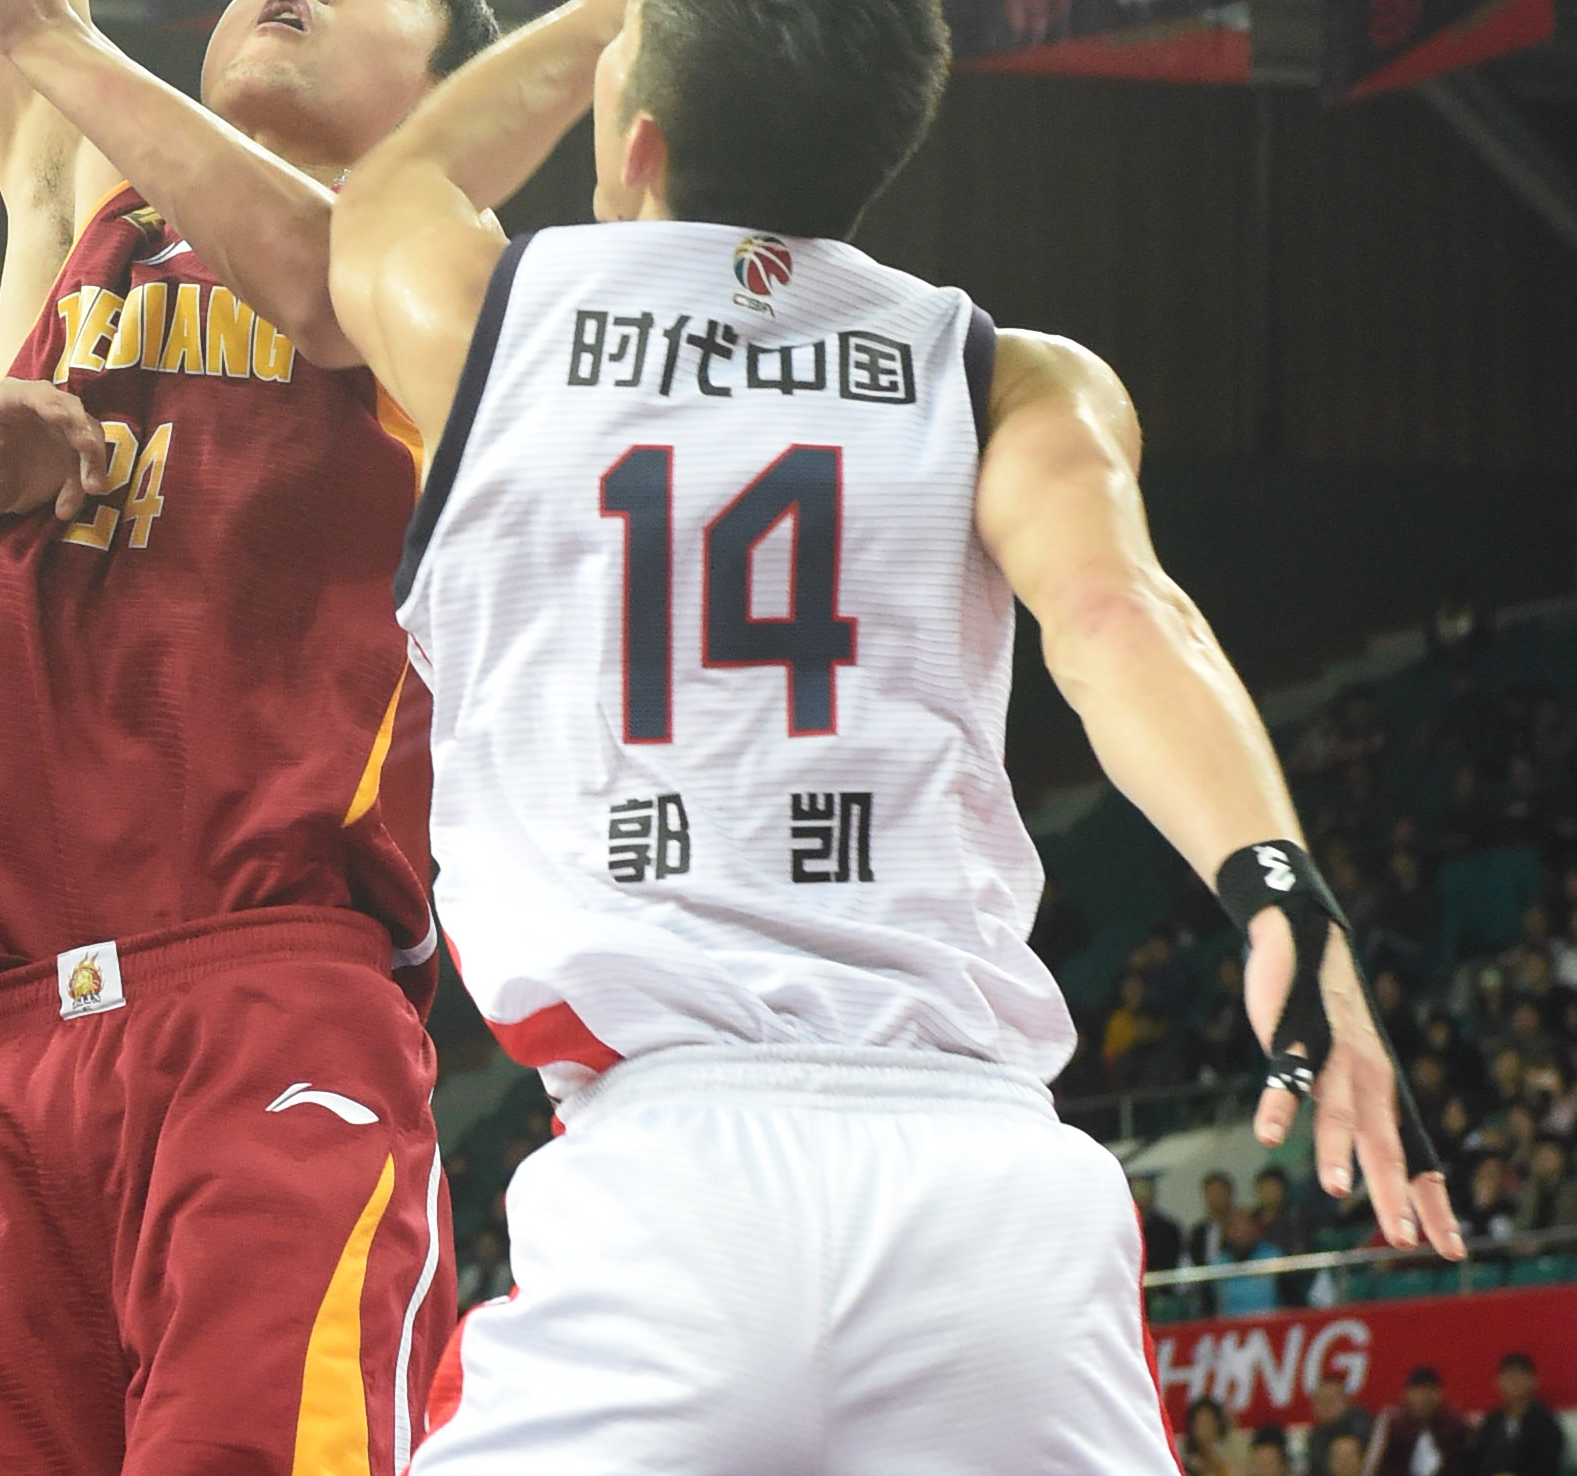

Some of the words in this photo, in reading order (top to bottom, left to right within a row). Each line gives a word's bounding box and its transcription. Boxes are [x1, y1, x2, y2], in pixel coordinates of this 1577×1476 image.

[567, 310, 916, 406] 时代中国
[54, 421, 174, 552] 24
[599, 443, 859, 746] 14
